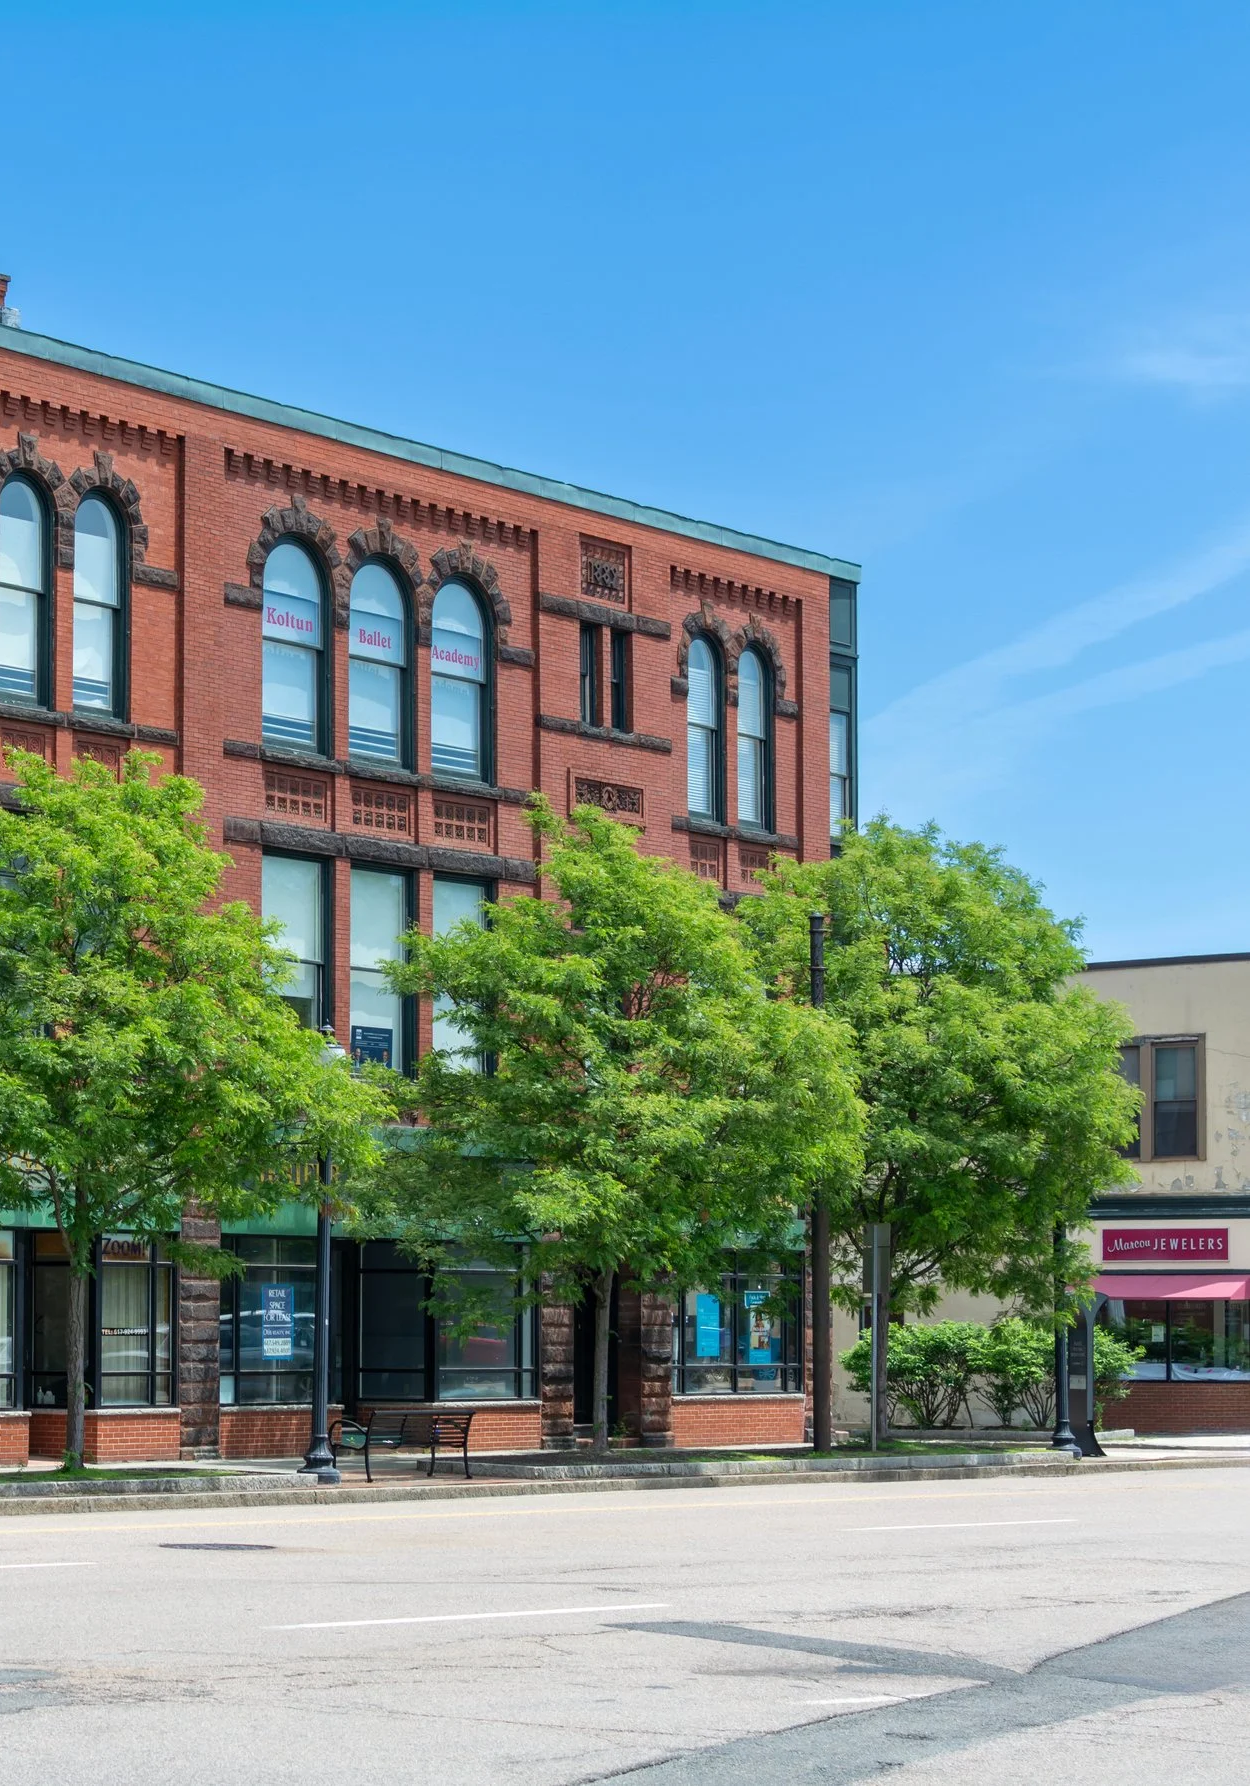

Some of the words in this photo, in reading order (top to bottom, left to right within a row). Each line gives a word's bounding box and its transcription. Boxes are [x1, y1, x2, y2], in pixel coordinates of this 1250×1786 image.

[266, 606, 313, 633] Koltun
[358, 628, 391, 650] Ballet
[431, 645, 480, 672] Academy
[1107, 1238, 1151, 1253] Marcou
[1153, 1238, 1223, 1251] JEWELERS
[268, 1289, 286, 1298] RETAIL
[269, 1301, 286, 1310] SPACE
[264, 1313, 276, 1322] FOR
[276, 1313, 292, 1322] LEASE
